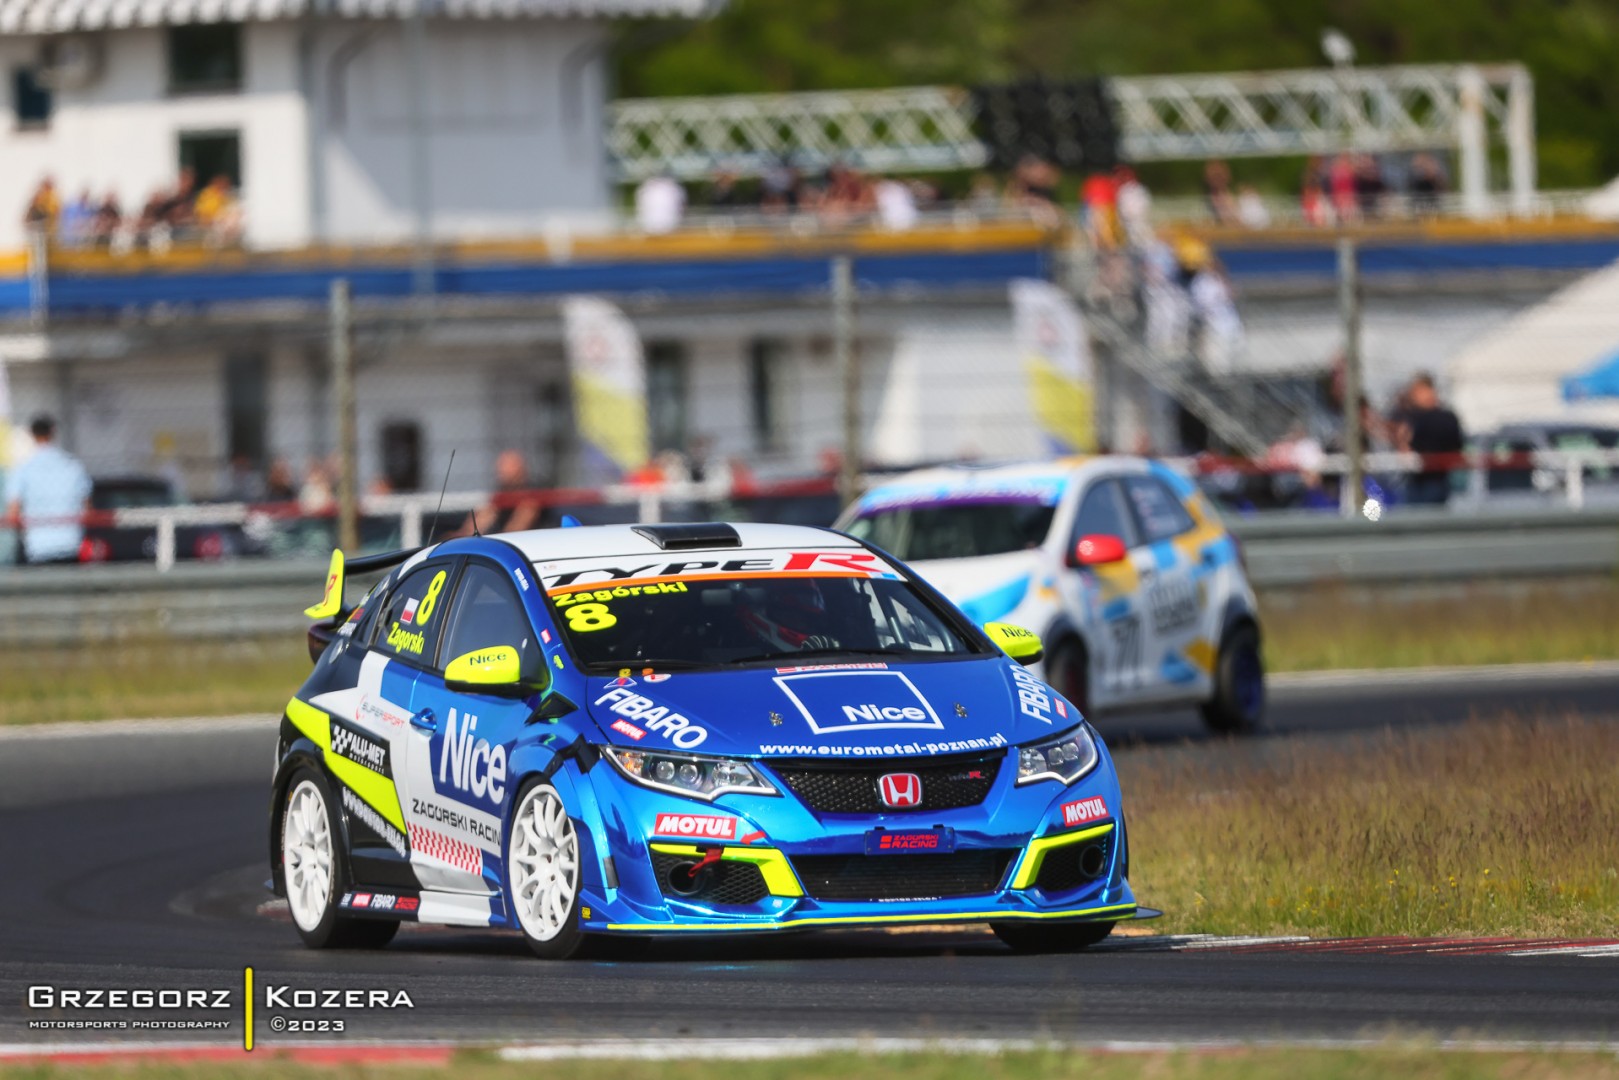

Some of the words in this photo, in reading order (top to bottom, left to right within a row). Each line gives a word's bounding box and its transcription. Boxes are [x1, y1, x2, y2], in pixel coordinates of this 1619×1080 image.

[543, 559, 774, 588] TYPE
[783, 553, 882, 573] R
[416, 570, 447, 626] 8
[565, 603, 617, 632] 8
[1001, 626, 1034, 638] Nice
[470, 652, 507, 666] Nice
[594, 687, 708, 749] FIBARO
[841, 704, 926, 722] Nice
[350, 734, 386, 767] ALU-MET
[439, 707, 507, 804] Nice
[759, 733, 1008, 756] www.eurometal-poznan.pl
[1065, 798, 1107, 823] MOTUL
[657, 815, 733, 836] MOTUL
